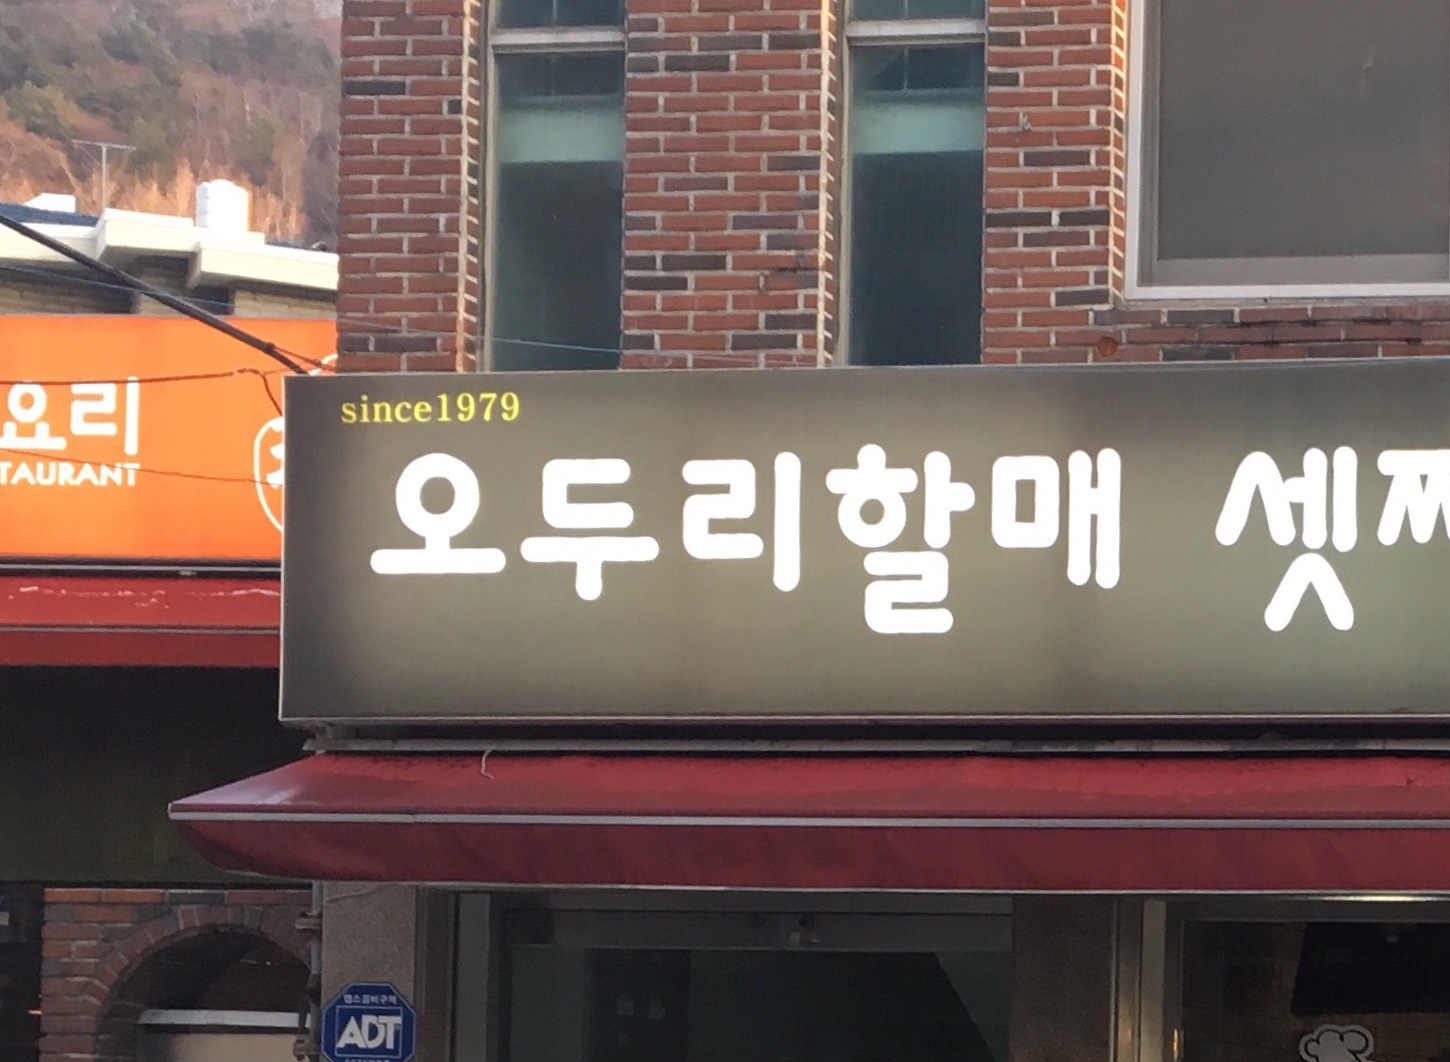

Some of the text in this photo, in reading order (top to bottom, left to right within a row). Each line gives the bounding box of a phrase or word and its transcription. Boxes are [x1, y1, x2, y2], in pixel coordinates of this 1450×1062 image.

[341, 392, 520, 423] since1979
[370, 443, 1121, 634] 오두리할매
[336, 1014, 402, 1050] ADT
